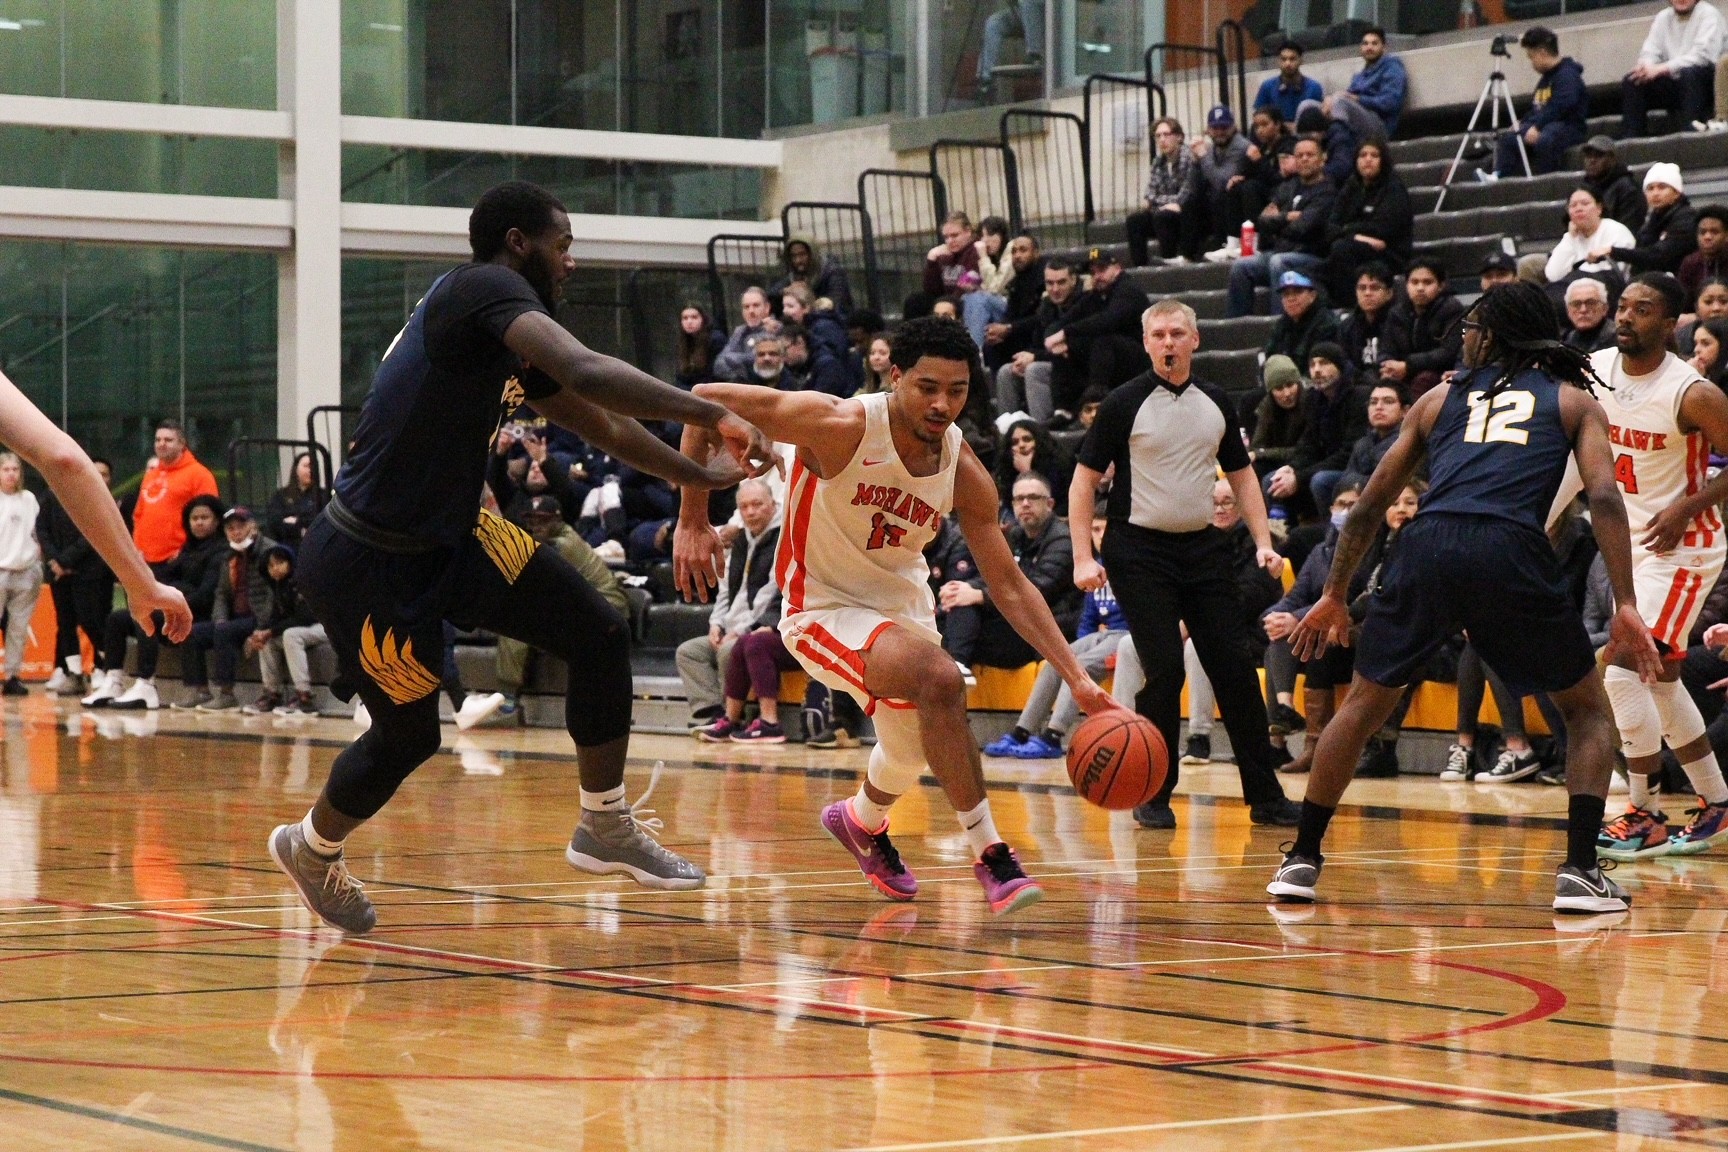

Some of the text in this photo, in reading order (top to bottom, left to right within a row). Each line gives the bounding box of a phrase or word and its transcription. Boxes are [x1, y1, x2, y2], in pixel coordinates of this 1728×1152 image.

[1463, 389, 1536, 446] 12
[1609, 424, 1667, 451] HAWK
[1615, 453, 1639, 495] 4
[1080, 745, 1116, 799] Wils
